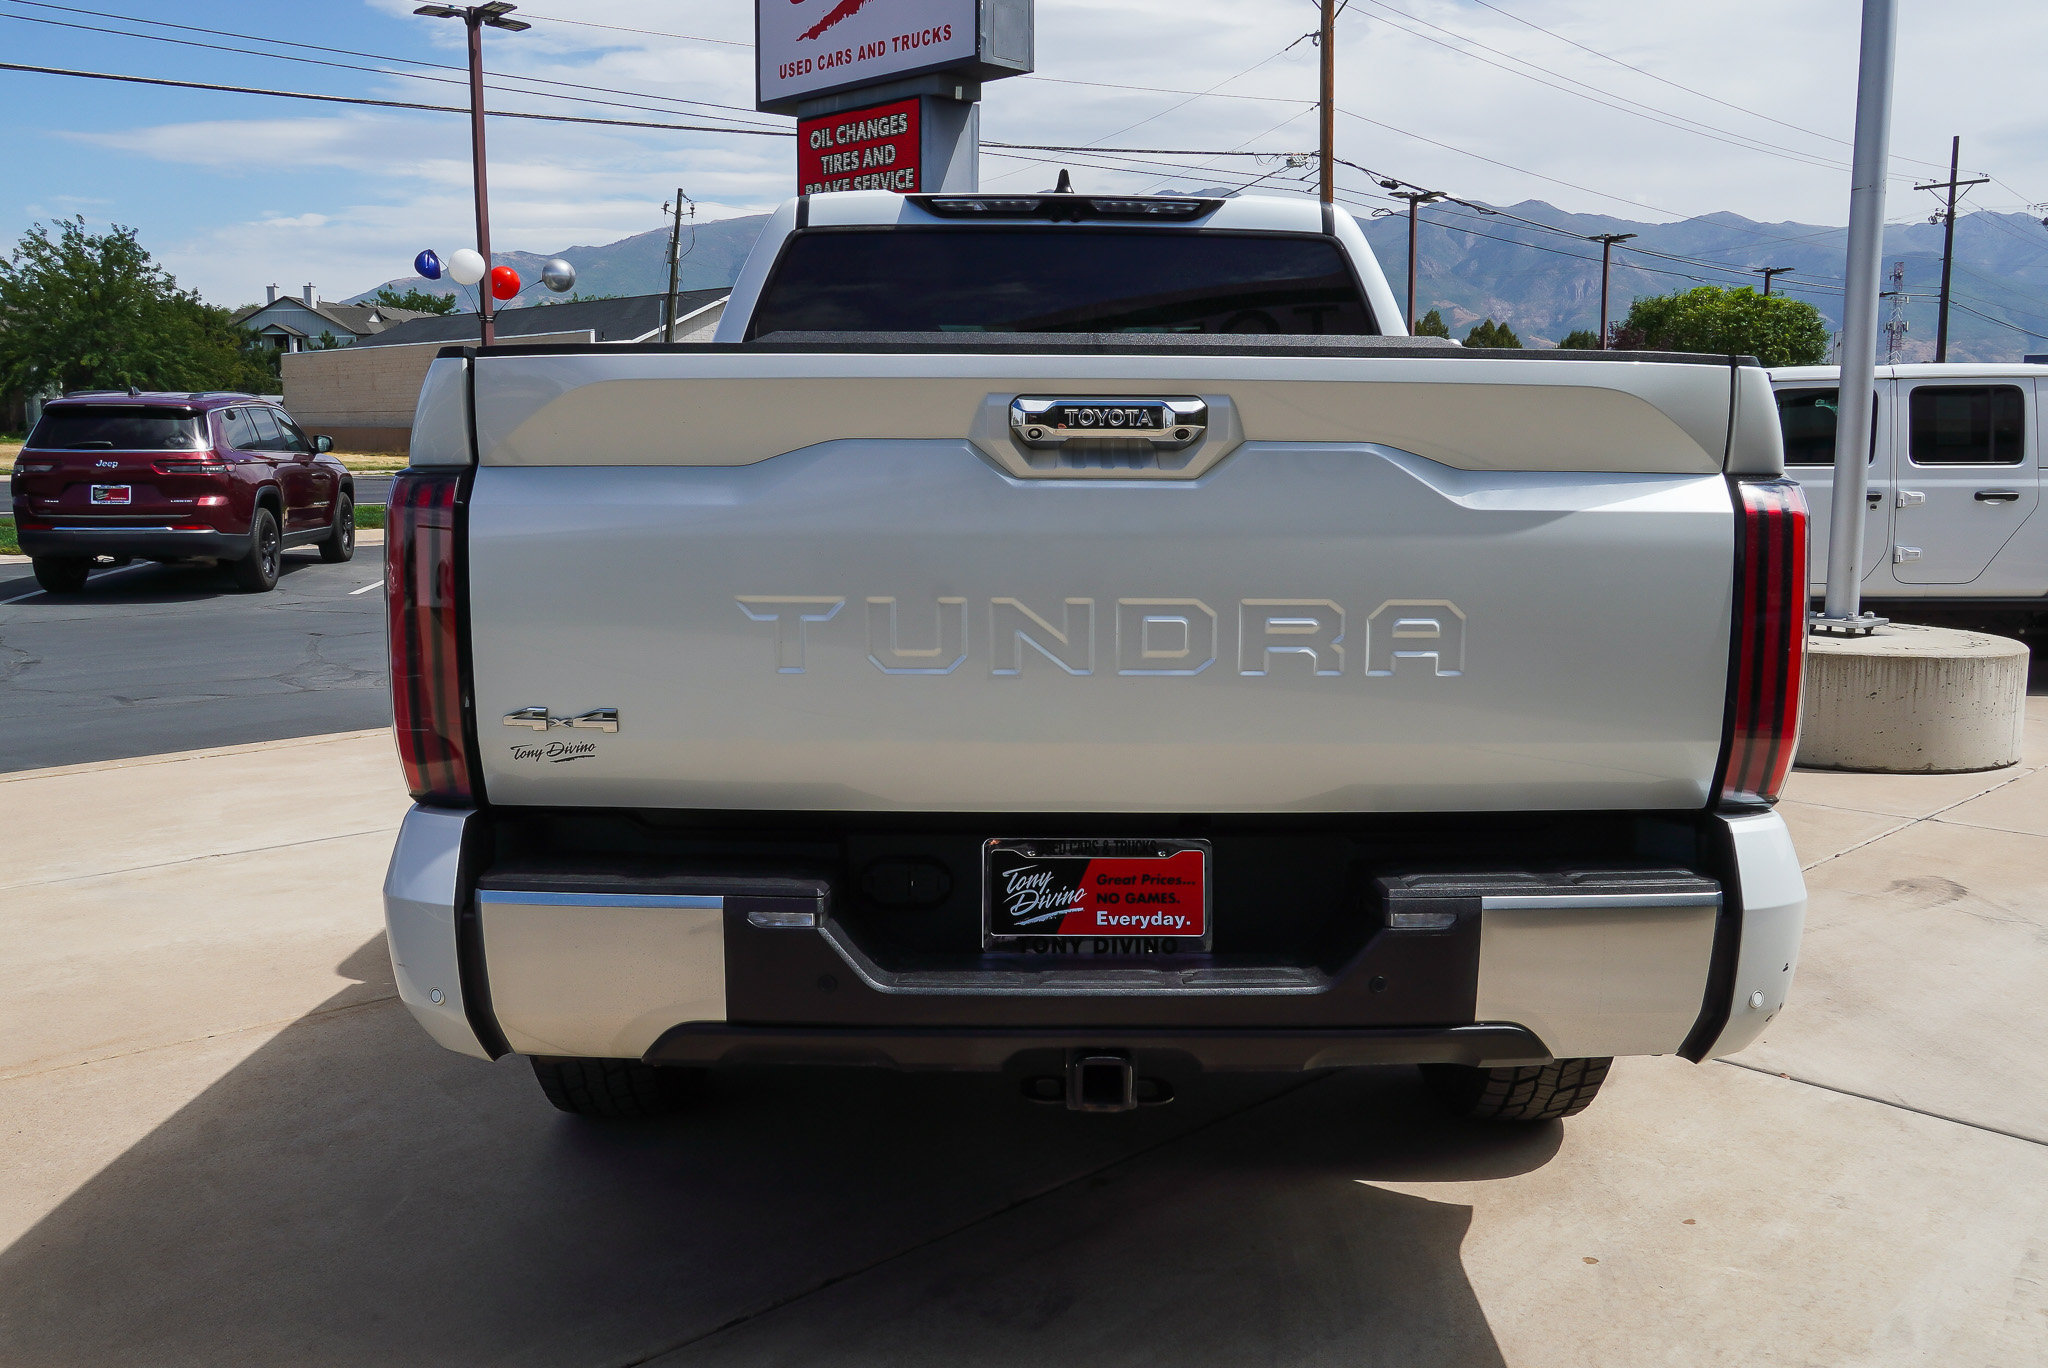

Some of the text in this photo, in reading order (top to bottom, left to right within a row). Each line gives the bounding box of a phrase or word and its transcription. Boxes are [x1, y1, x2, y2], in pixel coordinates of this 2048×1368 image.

[779, 24, 952, 80] USED CARS AND TRUCKS
[809, 113, 908, 150] OIL CHANGES
[820, 144, 896, 176] TIRES AND
[854, 168, 915, 191] SERVICE
[1064, 408, 1154, 427] TOYOTA
[95, 459, 119, 469] Jeep
[734, 595, 1467, 677] TUNDRA
[510, 741, 597, 762] Tony Divino
[1002, 864, 1054, 894] Tony
[1096, 873, 1196, 886] Great Prices...
[1003, 886, 1087, 916] Divino
[1096, 892, 1181, 904] NO GAMES.
[1096, 910, 1191, 929] Everyday.
[1094, 937, 1178, 954] DIVINO
